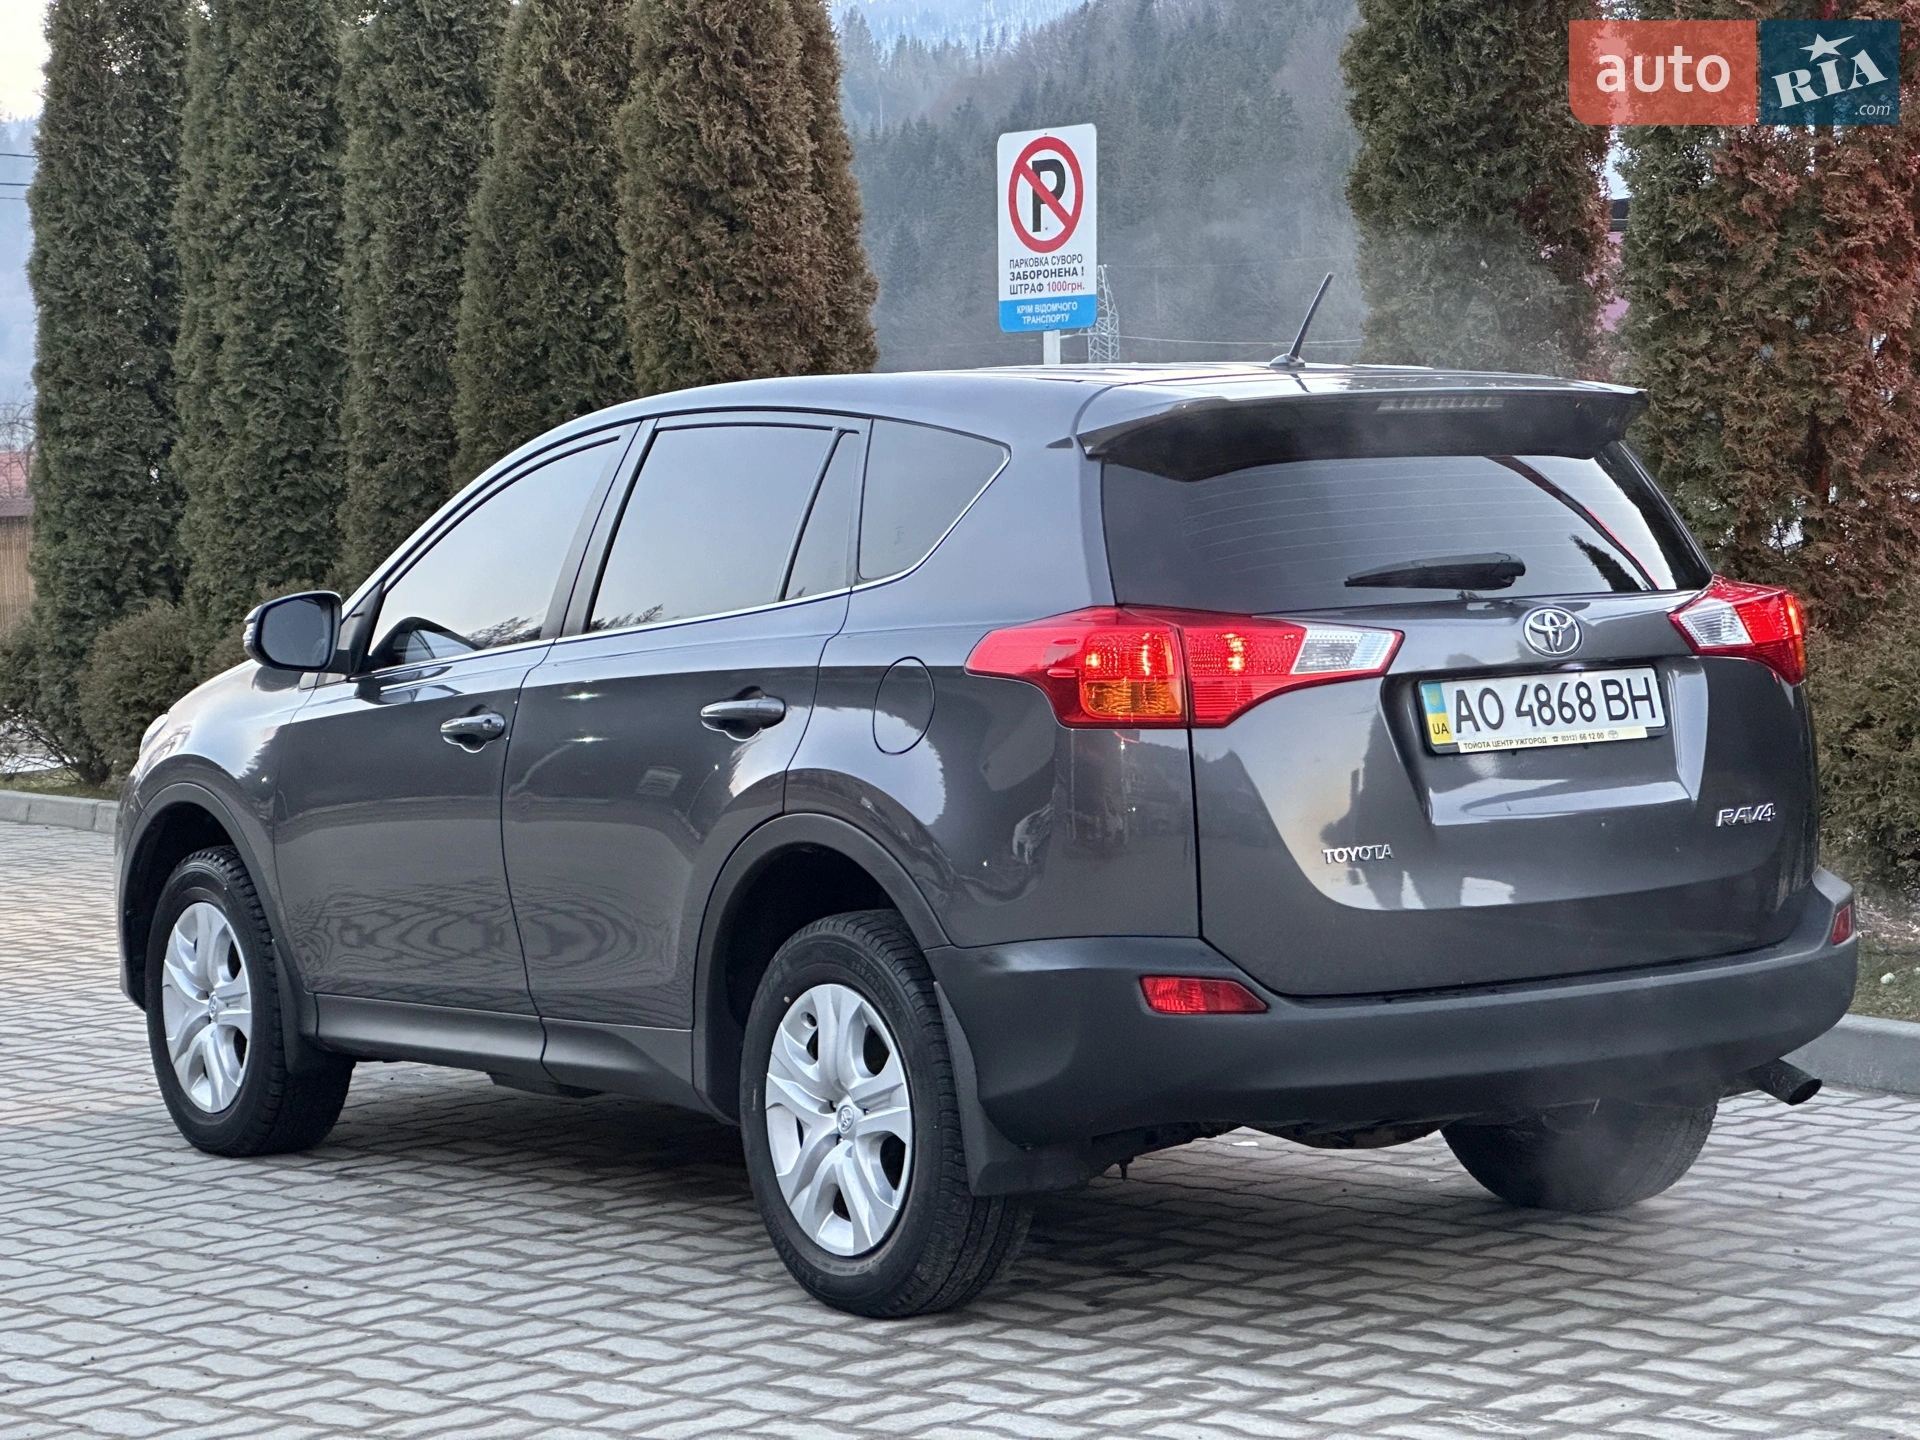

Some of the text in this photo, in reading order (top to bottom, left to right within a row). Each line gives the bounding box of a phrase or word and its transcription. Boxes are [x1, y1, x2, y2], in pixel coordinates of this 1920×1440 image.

[1009, 253, 1083, 269] ПАРКОВКА СУВОРО
[1009, 266, 1078, 281] ЗАБОРОНЕНА
[1009, 280, 1085, 295] ШТРАФ 1000грн.
[1016, 301, 1078, 315] КРІМ ВІДОМЧОГО
[1022, 312, 1070, 325] ТРАНСПОРТУ
[1456, 676, 1656, 734] AO 4868 BH
[1432, 723, 1450, 735] UA
[1464, 732, 1605, 750] ТОЙОТА ЦЕНТР УЖГОРОД (0312) 66 12 00
[1715, 802, 1777, 827] RAV4
[1321, 843, 1395, 865] TOYOTA
